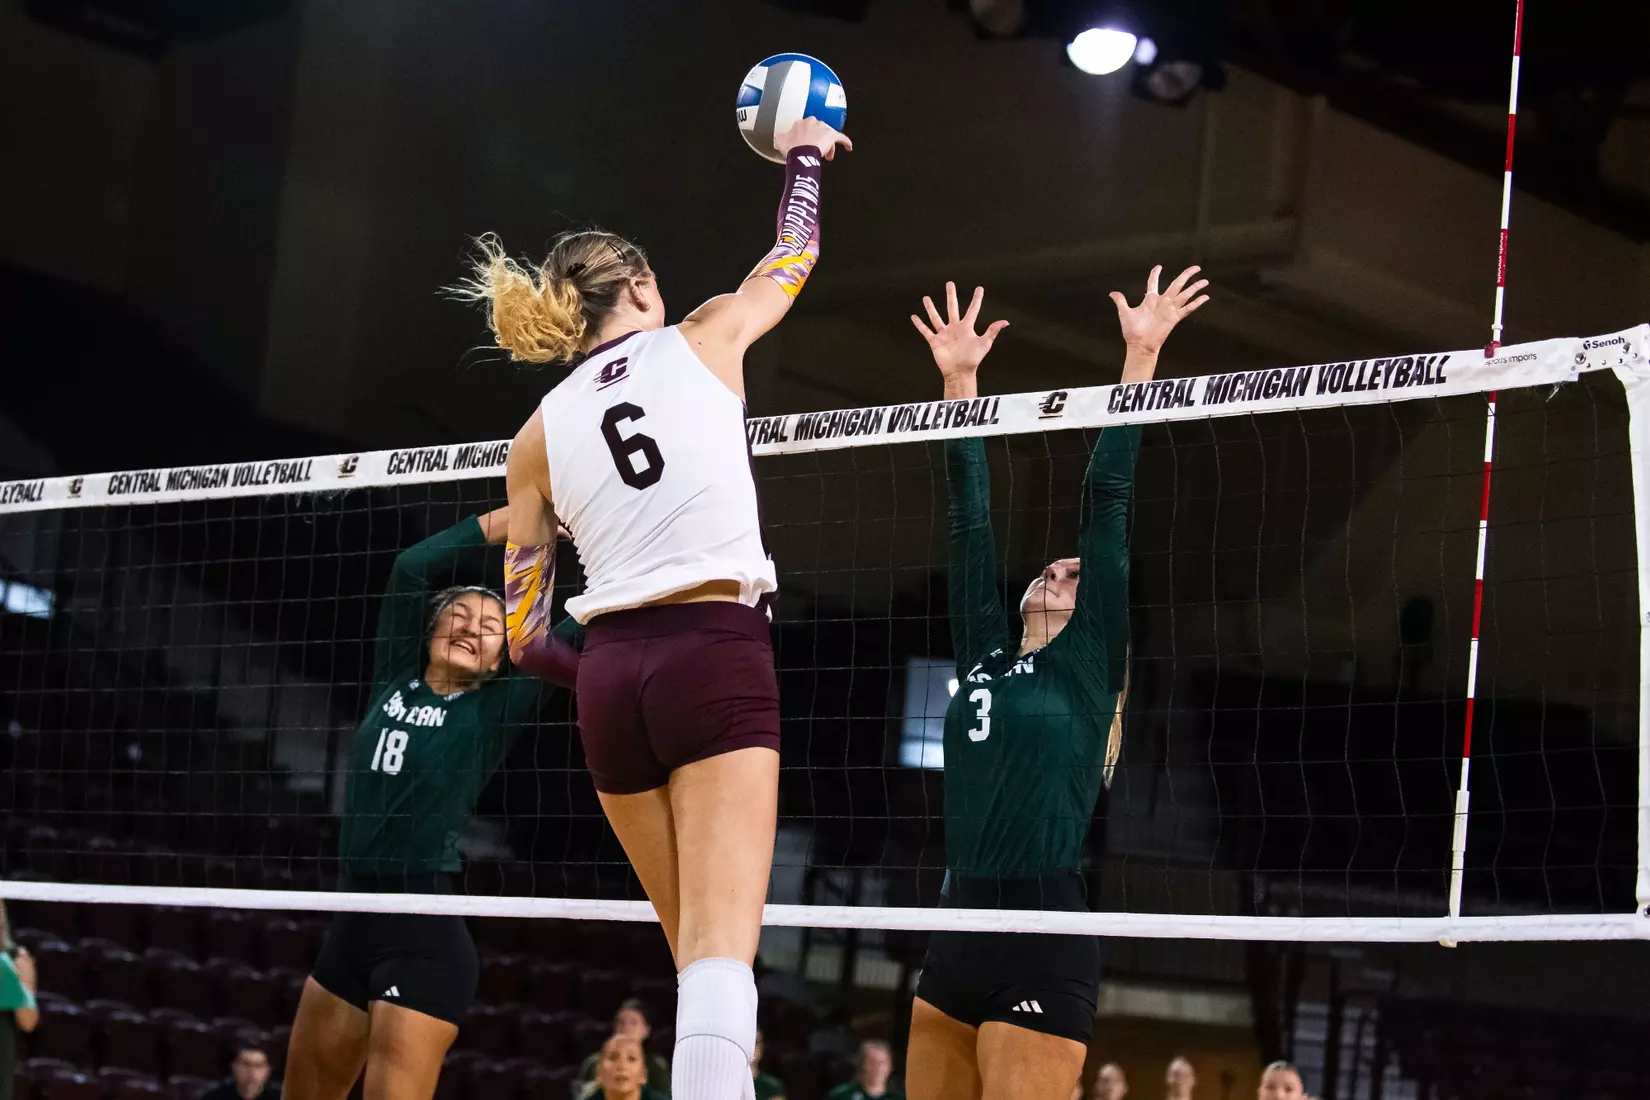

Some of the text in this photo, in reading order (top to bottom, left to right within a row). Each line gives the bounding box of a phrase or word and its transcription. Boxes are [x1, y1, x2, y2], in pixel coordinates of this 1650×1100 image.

[778, 174, 820, 256] CHIPPEWAS
[1592, 336, 1625, 349] Senoh
[1107, 354, 1452, 415] CENTRAL MICHIGAN VOLLEYBALL
[793, 408, 882, 441] MICHIGAN
[887, 396, 1000, 434] VOLLEYBALL
[387, 449, 449, 475] CENTRAL
[600, 401, 665, 491] 6
[0, 481, 44, 504] EYBALL
[107, 459, 313, 496] CENTRAL MICHIGAN VOLLEYBALL
[968, 688, 992, 742] 3
[371, 728, 409, 776] 18
